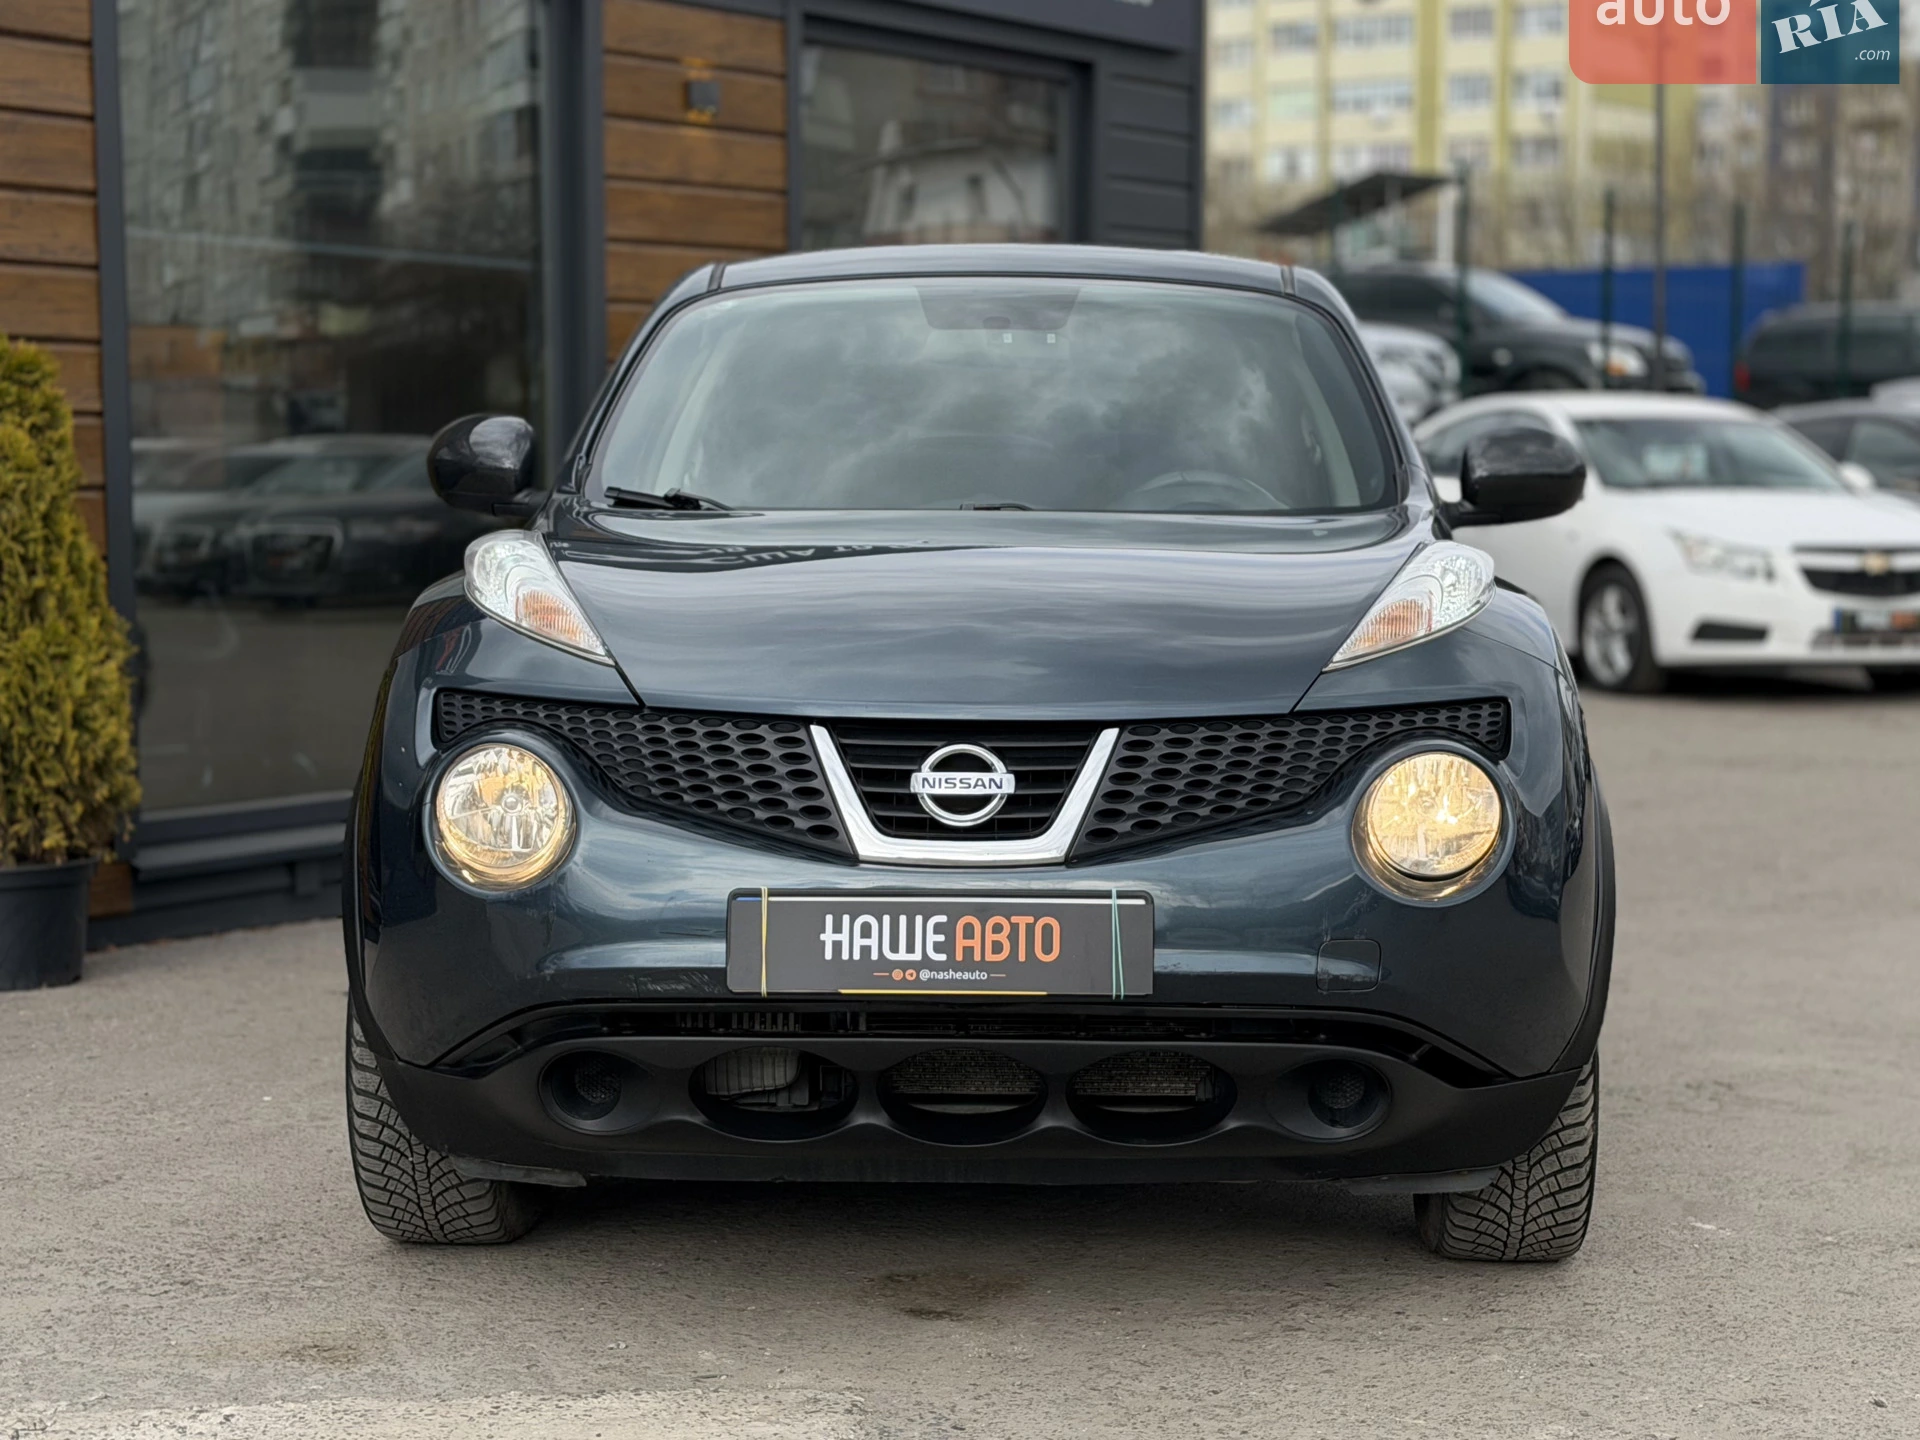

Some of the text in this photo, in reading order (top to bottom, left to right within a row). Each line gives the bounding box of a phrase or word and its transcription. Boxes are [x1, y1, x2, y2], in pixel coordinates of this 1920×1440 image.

[921, 777, 1004, 790] NISSAN
[819, 913, 1061, 963] НАШЕ АВТО
[919, 968, 988, 981] @nasheauto
